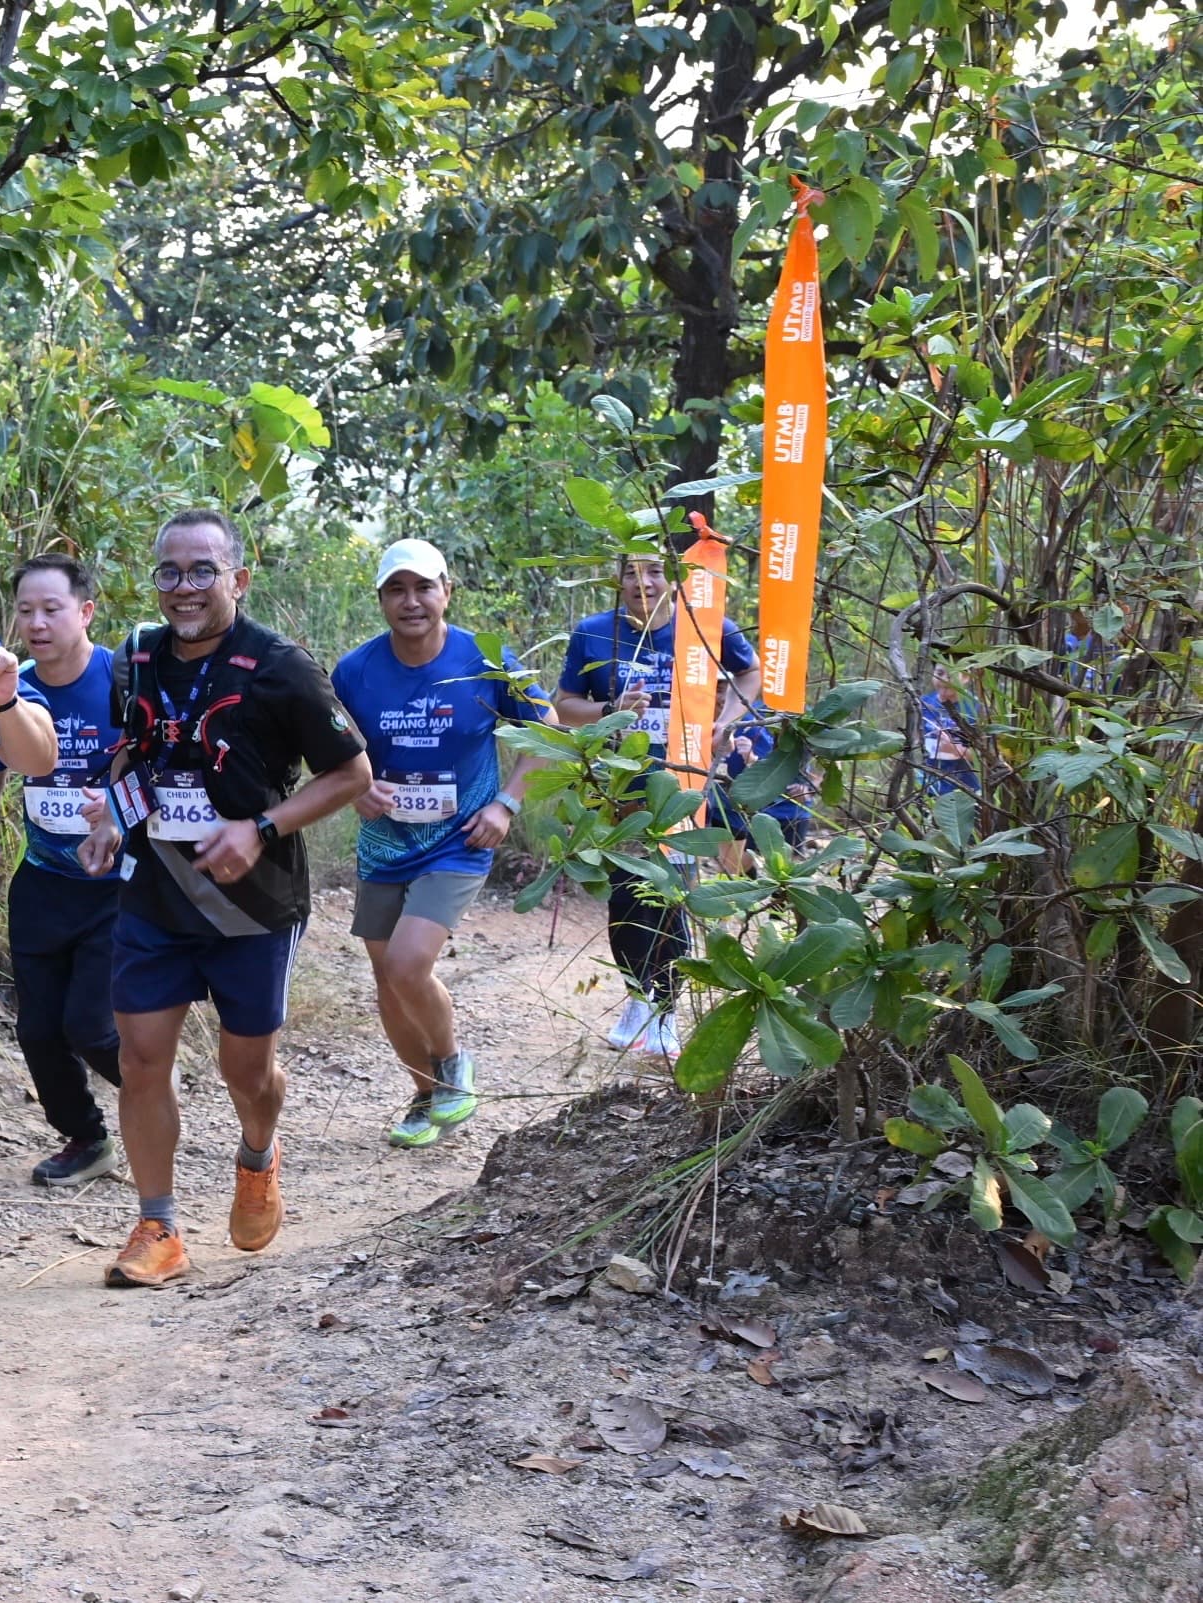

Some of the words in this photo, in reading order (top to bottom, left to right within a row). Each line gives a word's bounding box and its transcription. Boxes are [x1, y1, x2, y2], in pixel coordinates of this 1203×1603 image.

[804, 283, 815, 309] SERIES
[802, 311, 812, 340] WORLD
[796, 406, 806, 430] SERIES
[774, 403, 795, 463] UTMB
[792, 433, 803, 461] WORLD
[787, 525, 796, 549] SERIES
[767, 521, 786, 580] UTMB
[784, 552, 793, 579] WORLD
[763, 638, 778, 694] UTMB
[775, 667, 784, 694] WORLD
[379, 718, 427, 730] CHIANG
[429, 717, 453, 728] MAI
[75, 739, 99, 750] MAI
[166, 791, 191, 799] CHEDI
[195, 791, 207, 799] 10
[160, 804, 216, 823] 8463
